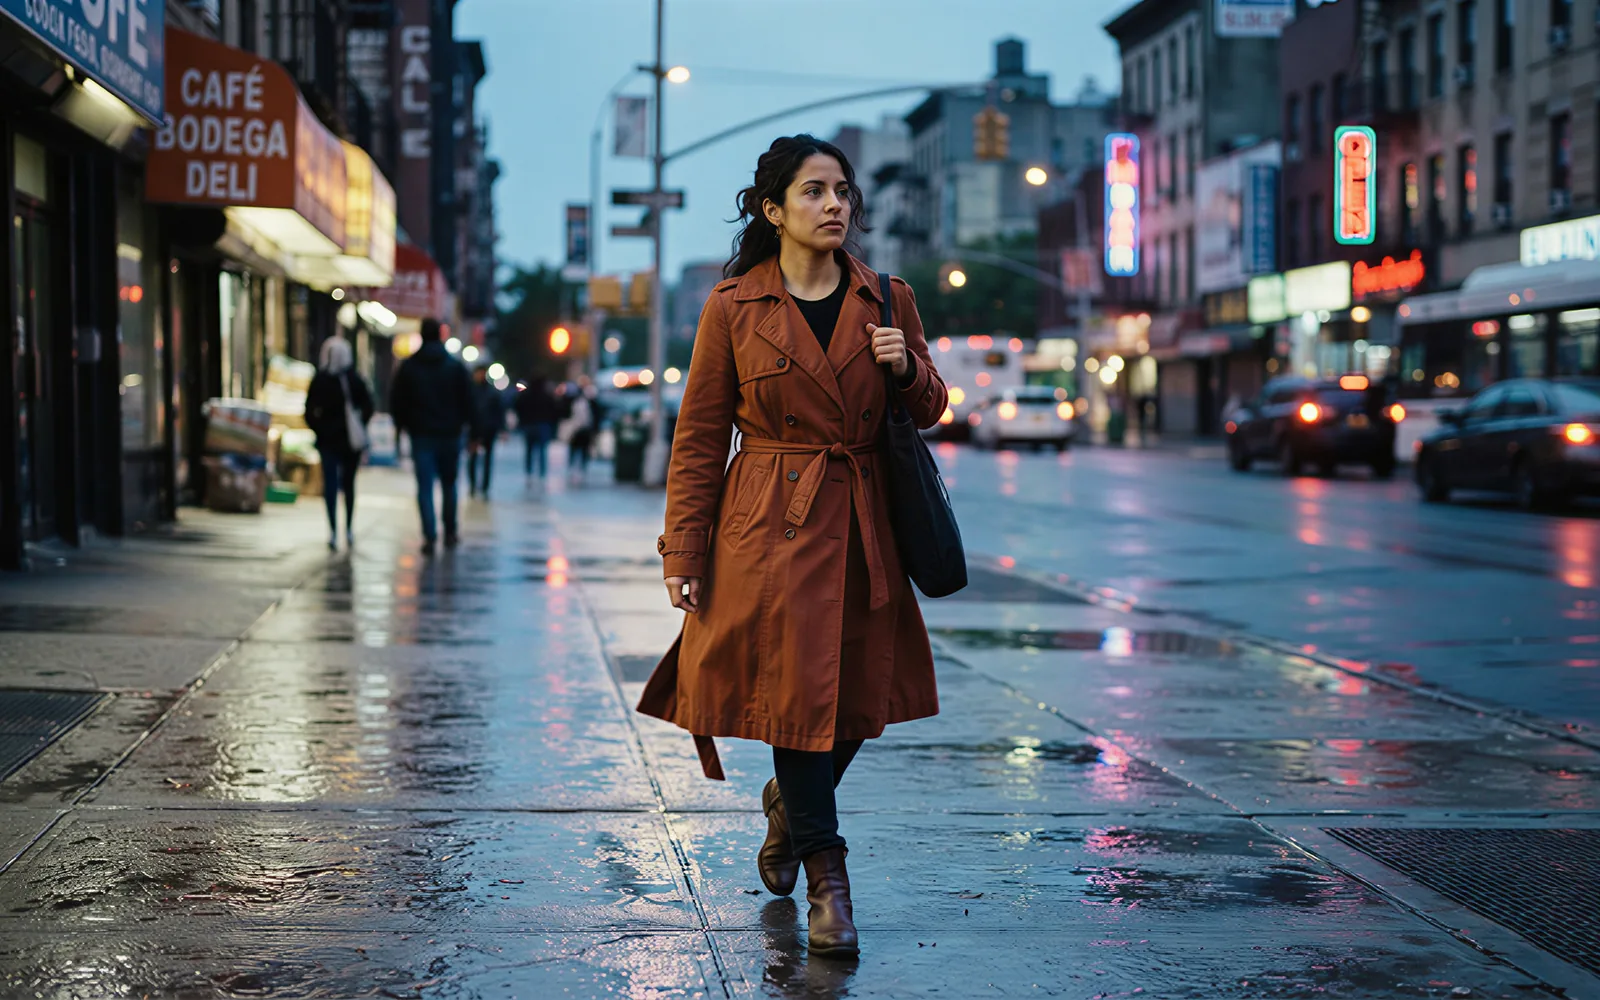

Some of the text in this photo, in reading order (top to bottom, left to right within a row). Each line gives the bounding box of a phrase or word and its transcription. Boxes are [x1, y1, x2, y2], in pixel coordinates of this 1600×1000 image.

[181, 64, 264, 112] CAFÉ
[155, 113, 288, 159] BODEGA
[186, 160, 257, 202] DELI
